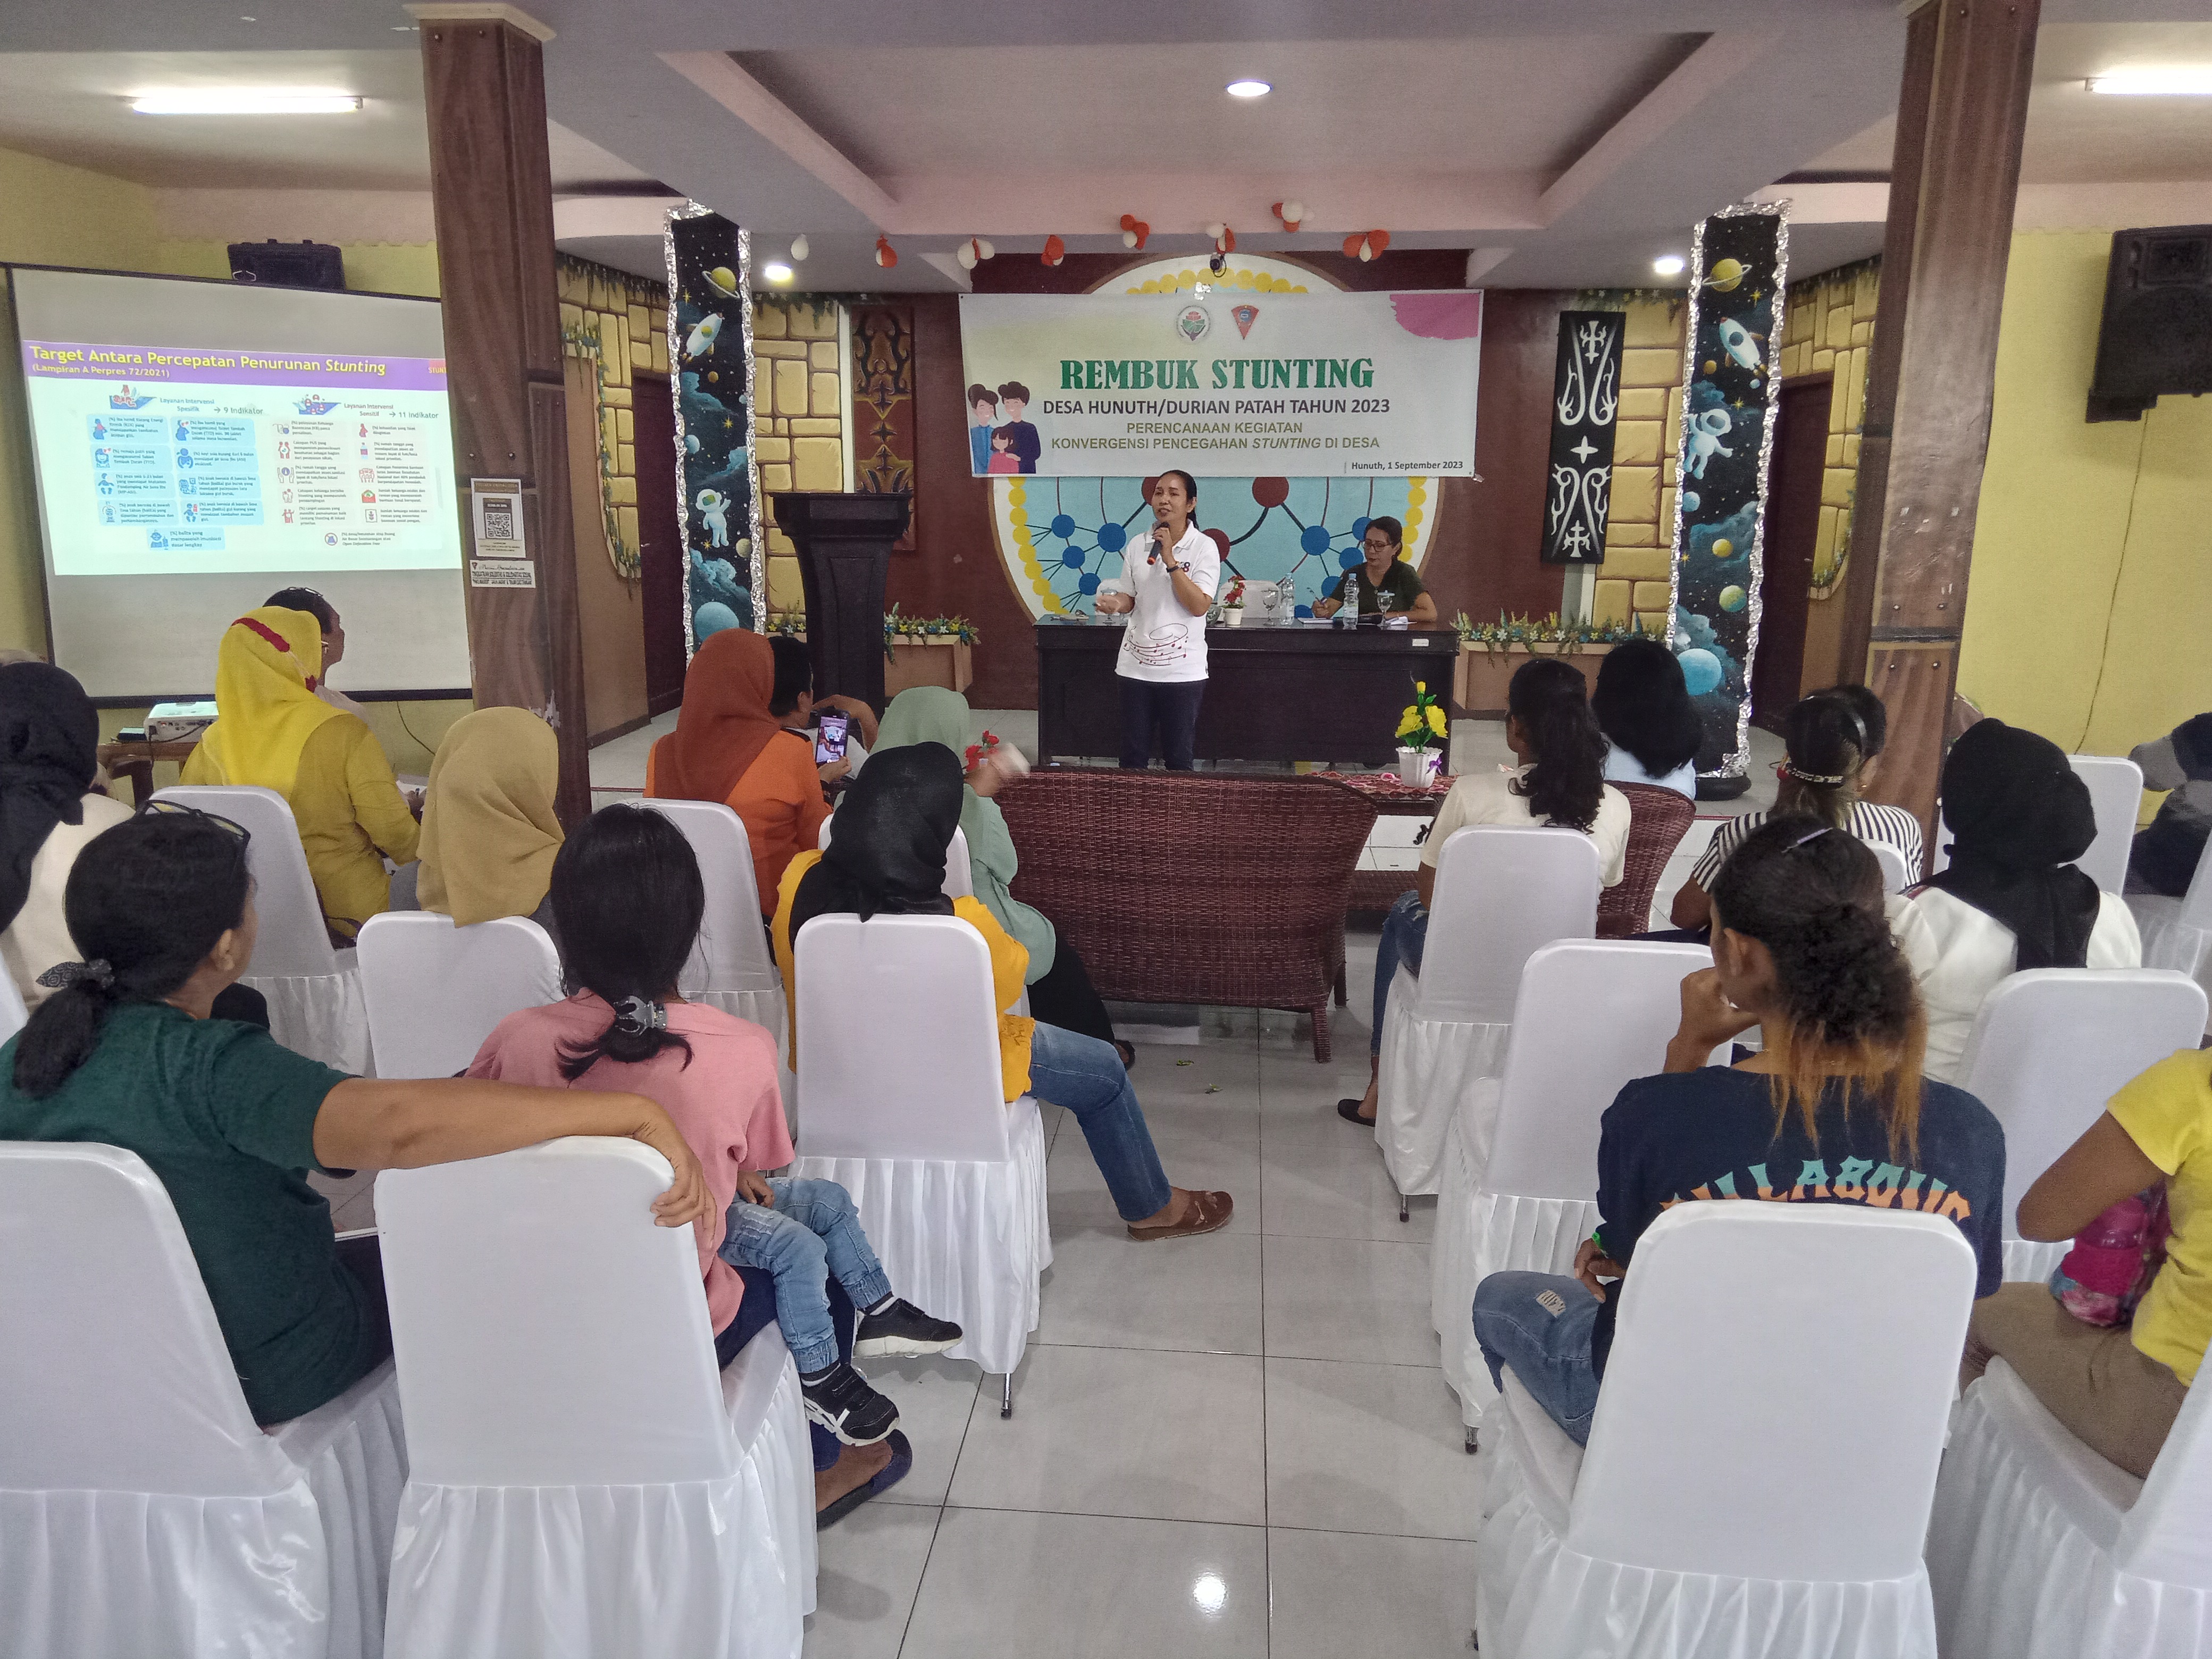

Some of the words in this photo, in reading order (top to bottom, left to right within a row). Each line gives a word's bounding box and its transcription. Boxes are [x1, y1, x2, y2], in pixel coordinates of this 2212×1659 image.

[29, 346, 85, 364] Target
[89, 349, 143, 364] Antara
[147, 351, 236, 370] Percepatan
[240, 356, 321, 371] Penurunan
[325, 359, 386, 376] Stunting
[32, 363, 80, 374] (Lampiran
[91, 366, 127, 376] Perpres
[129, 368, 170, 378] 72/2021)
[1060, 360, 1199, 389] REMBUK
[1212, 358, 1375, 389] STUNTING
[1044, 400, 1084, 414] DESA
[1088, 399, 1229, 417] HUNUTH/DURIAN
[1235, 400, 1285, 414] PATAH
[1289, 399, 1346, 414] TAHUN
[1351, 399, 1390, 413] 2023
[1127, 422, 1230, 434] PERENCANAAN
[1235, 422, 1302, 433] KEGIATAN
[1052, 438, 1149, 449] KONVERGENSI
[1153, 438, 1247, 449] PENCEGAHAN
[1252, 438, 1321, 449] STUNTING
[1325, 438, 1338, 448] DI
[1342, 437, 1380, 448] DESA
[1352, 462, 1385, 471] Hunuth,
[1395, 461, 1441, 471] September
